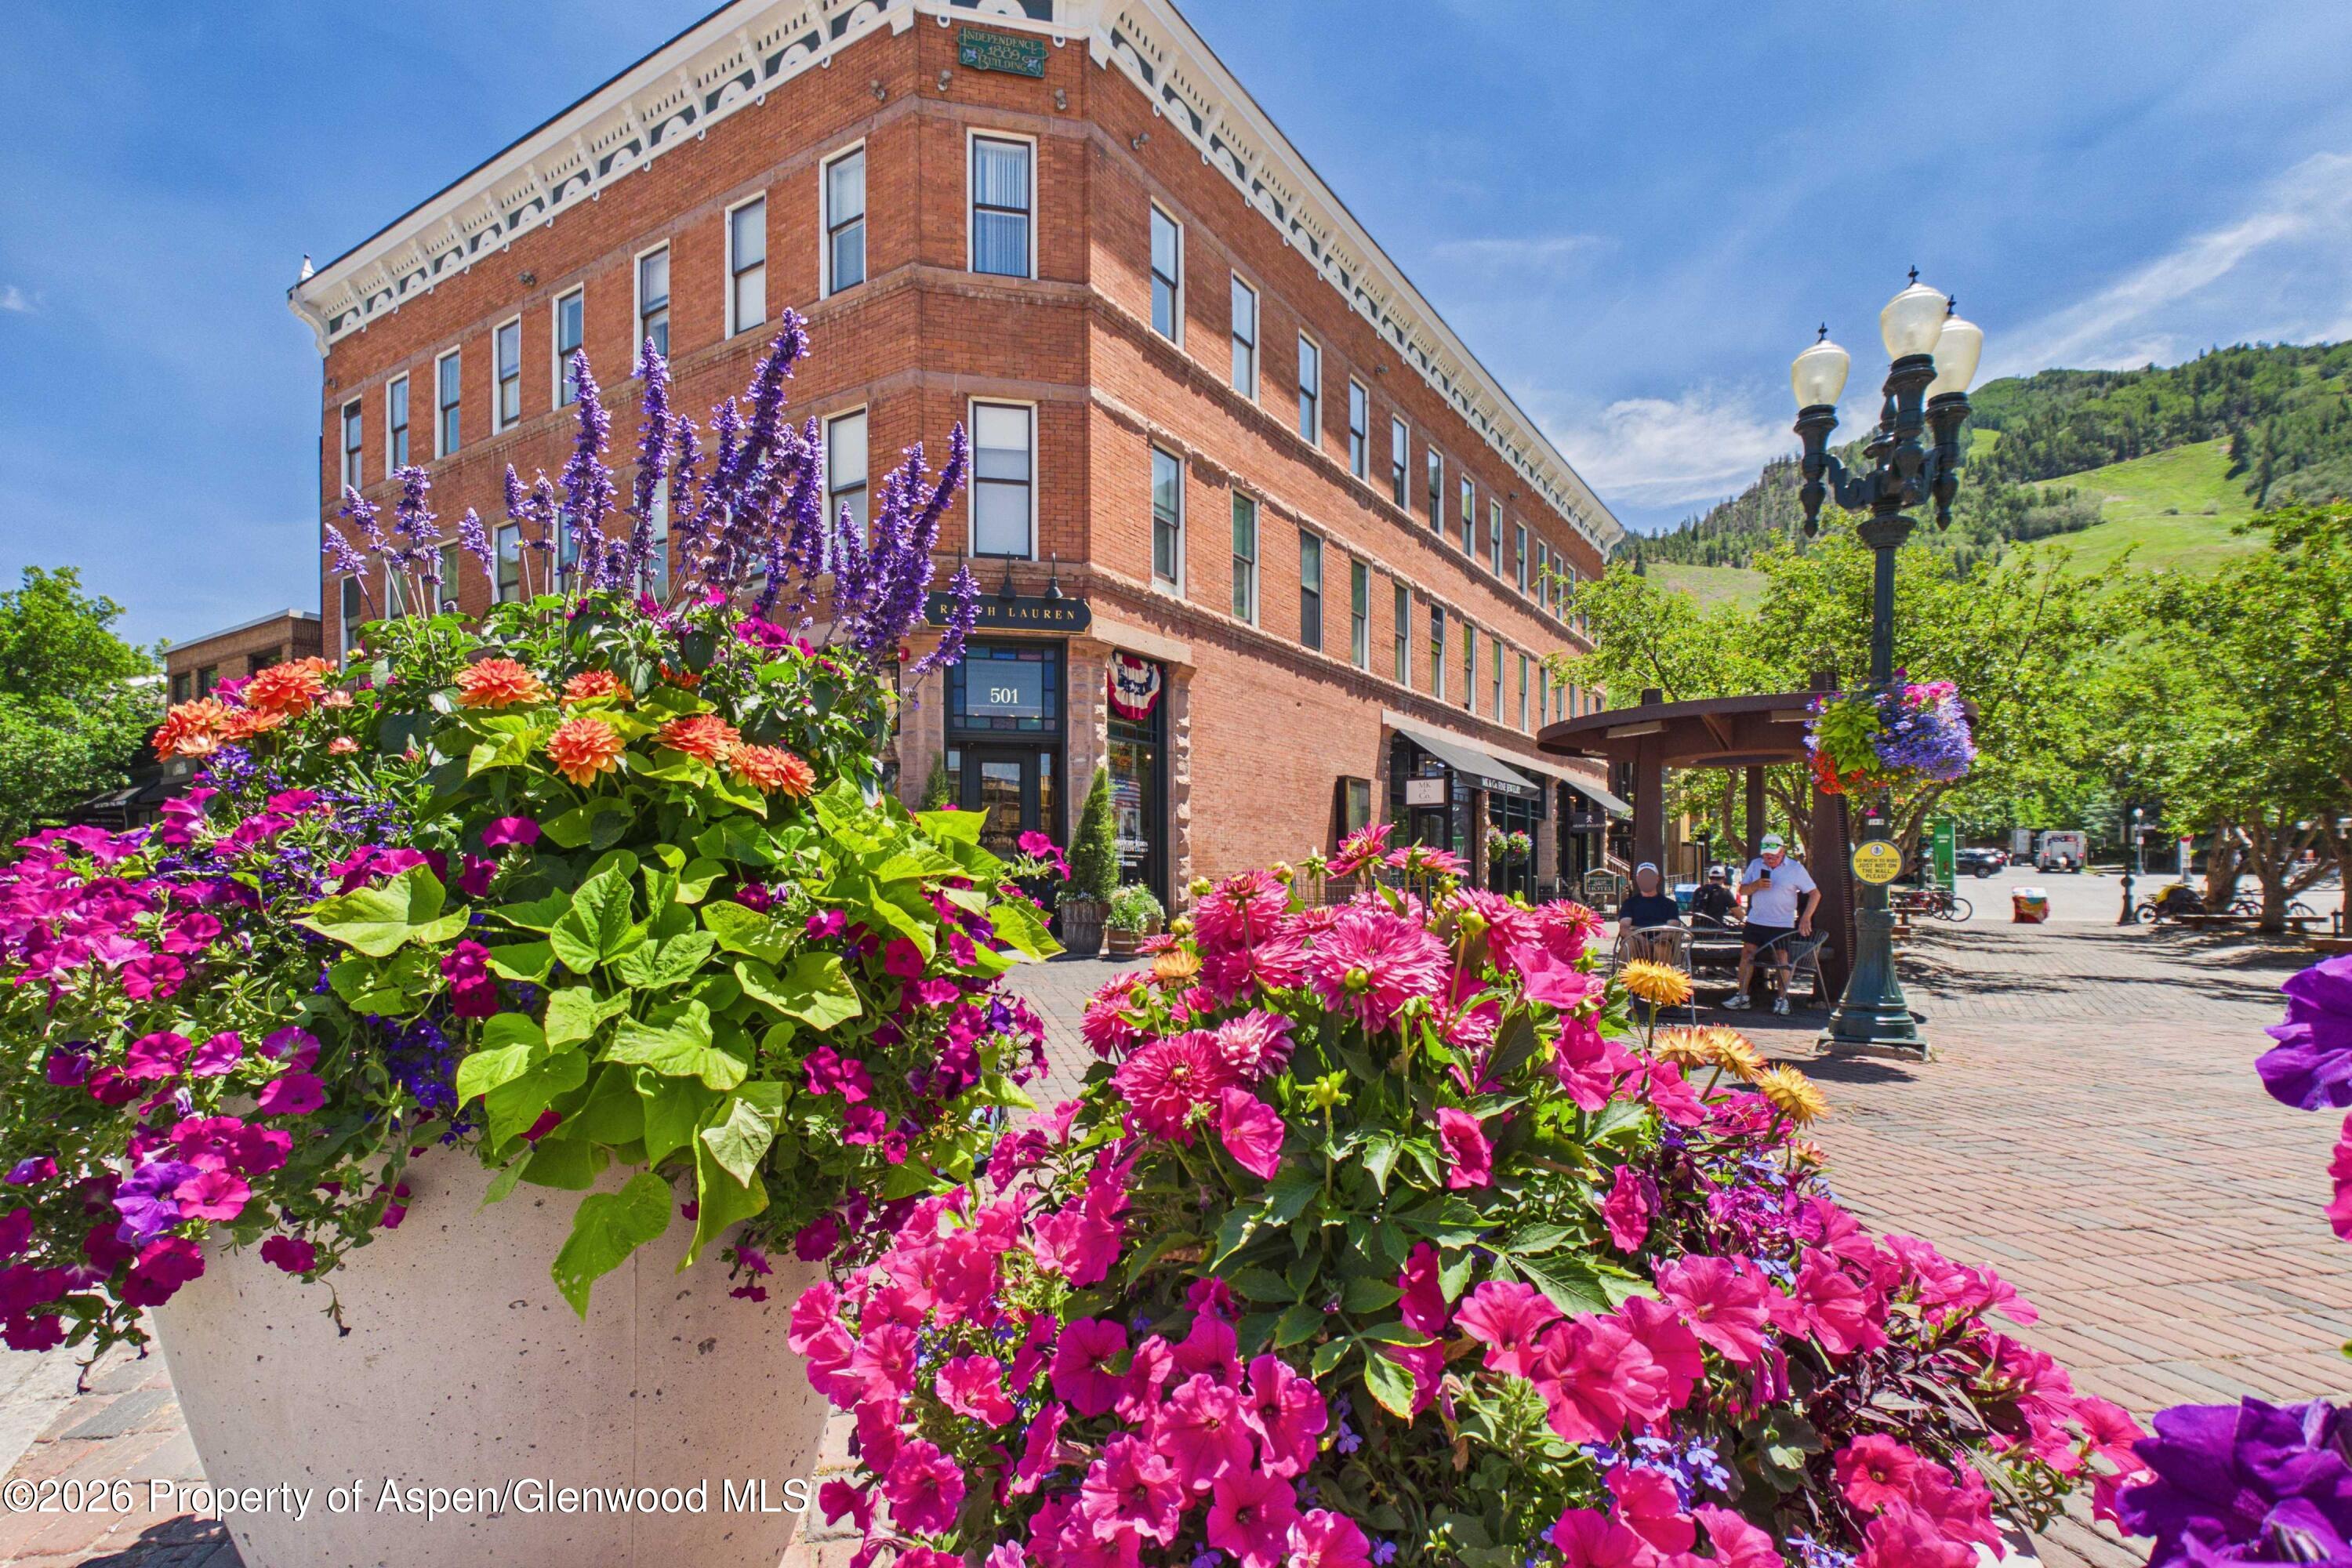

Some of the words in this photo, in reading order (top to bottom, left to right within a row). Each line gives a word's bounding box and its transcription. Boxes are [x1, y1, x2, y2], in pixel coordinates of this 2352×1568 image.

[964, 27, 1037, 54] INDEPENDENCE
[978, 55, 1028, 71] BUILDING
[940, 604, 996, 616] RAPH
[1008, 608, 1076, 620] LAUREN
[990, 688, 1018, 704] 501
